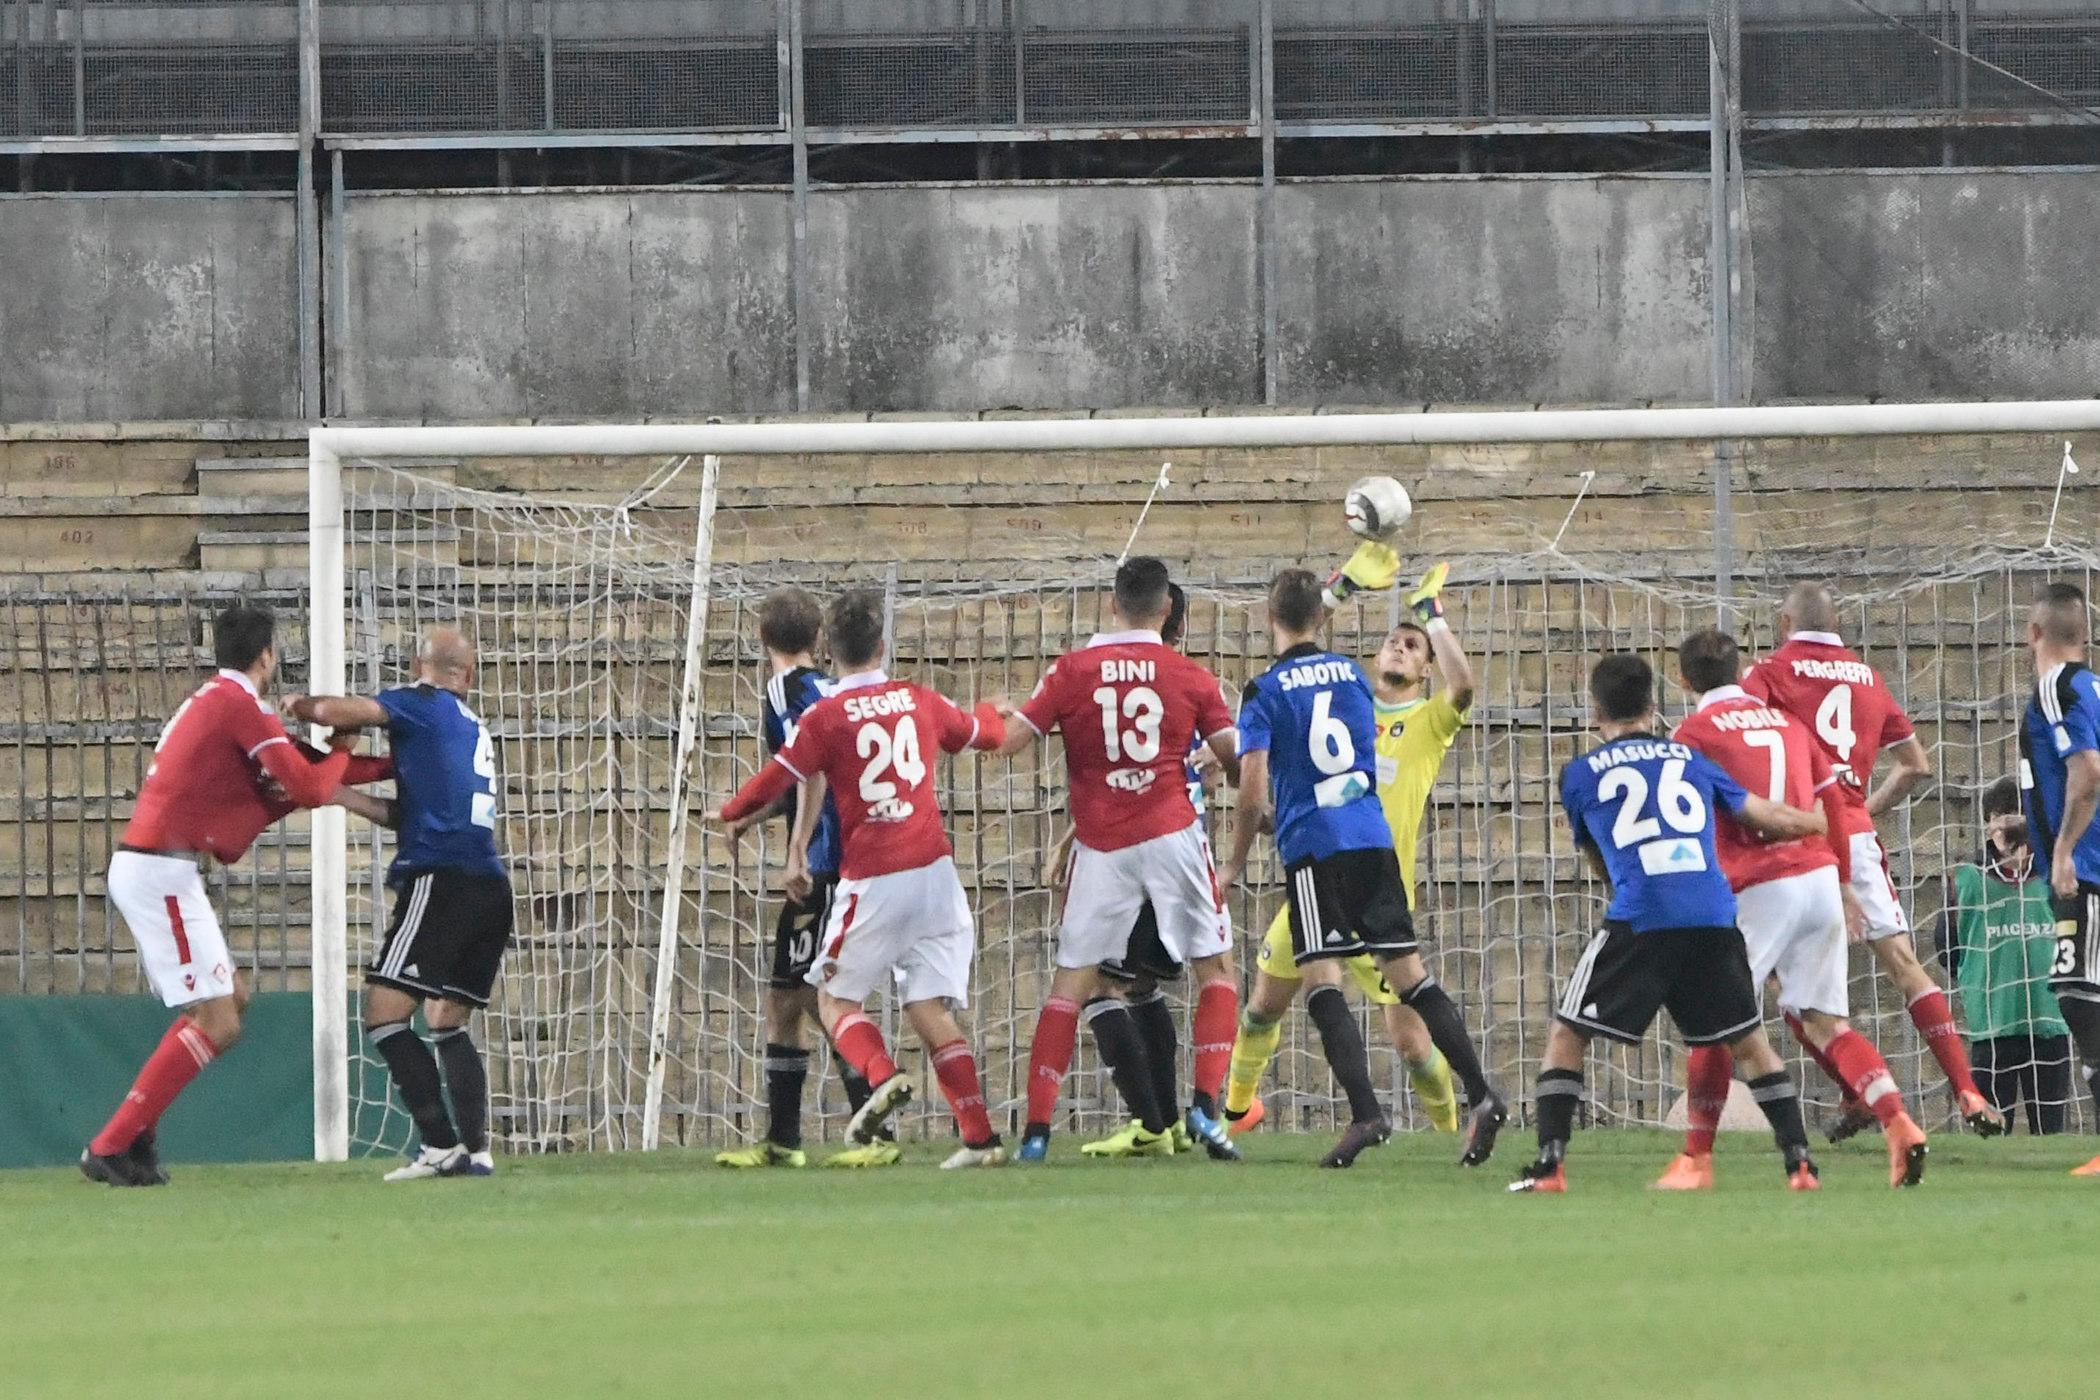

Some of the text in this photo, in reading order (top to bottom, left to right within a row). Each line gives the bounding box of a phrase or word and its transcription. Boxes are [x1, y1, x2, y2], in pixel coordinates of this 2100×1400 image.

[1101, 659, 1155, 682] BINI
[1278, 661, 1356, 691] SABOTIC
[1791, 659, 1873, 687] PERGREFFI
[843, 688, 916, 722] SEGRE
[1093, 686, 1164, 762] 13
[1711, 708, 1789, 732] NOBILE
[1815, 684, 1856, 762] 4
[856, 715, 926, 802] 24
[1308, 690, 1355, 775] 6
[1588, 743, 1692, 773] MASUCCI
[1743, 729, 1786, 804] 7
[1598, 759, 1706, 849] 26
